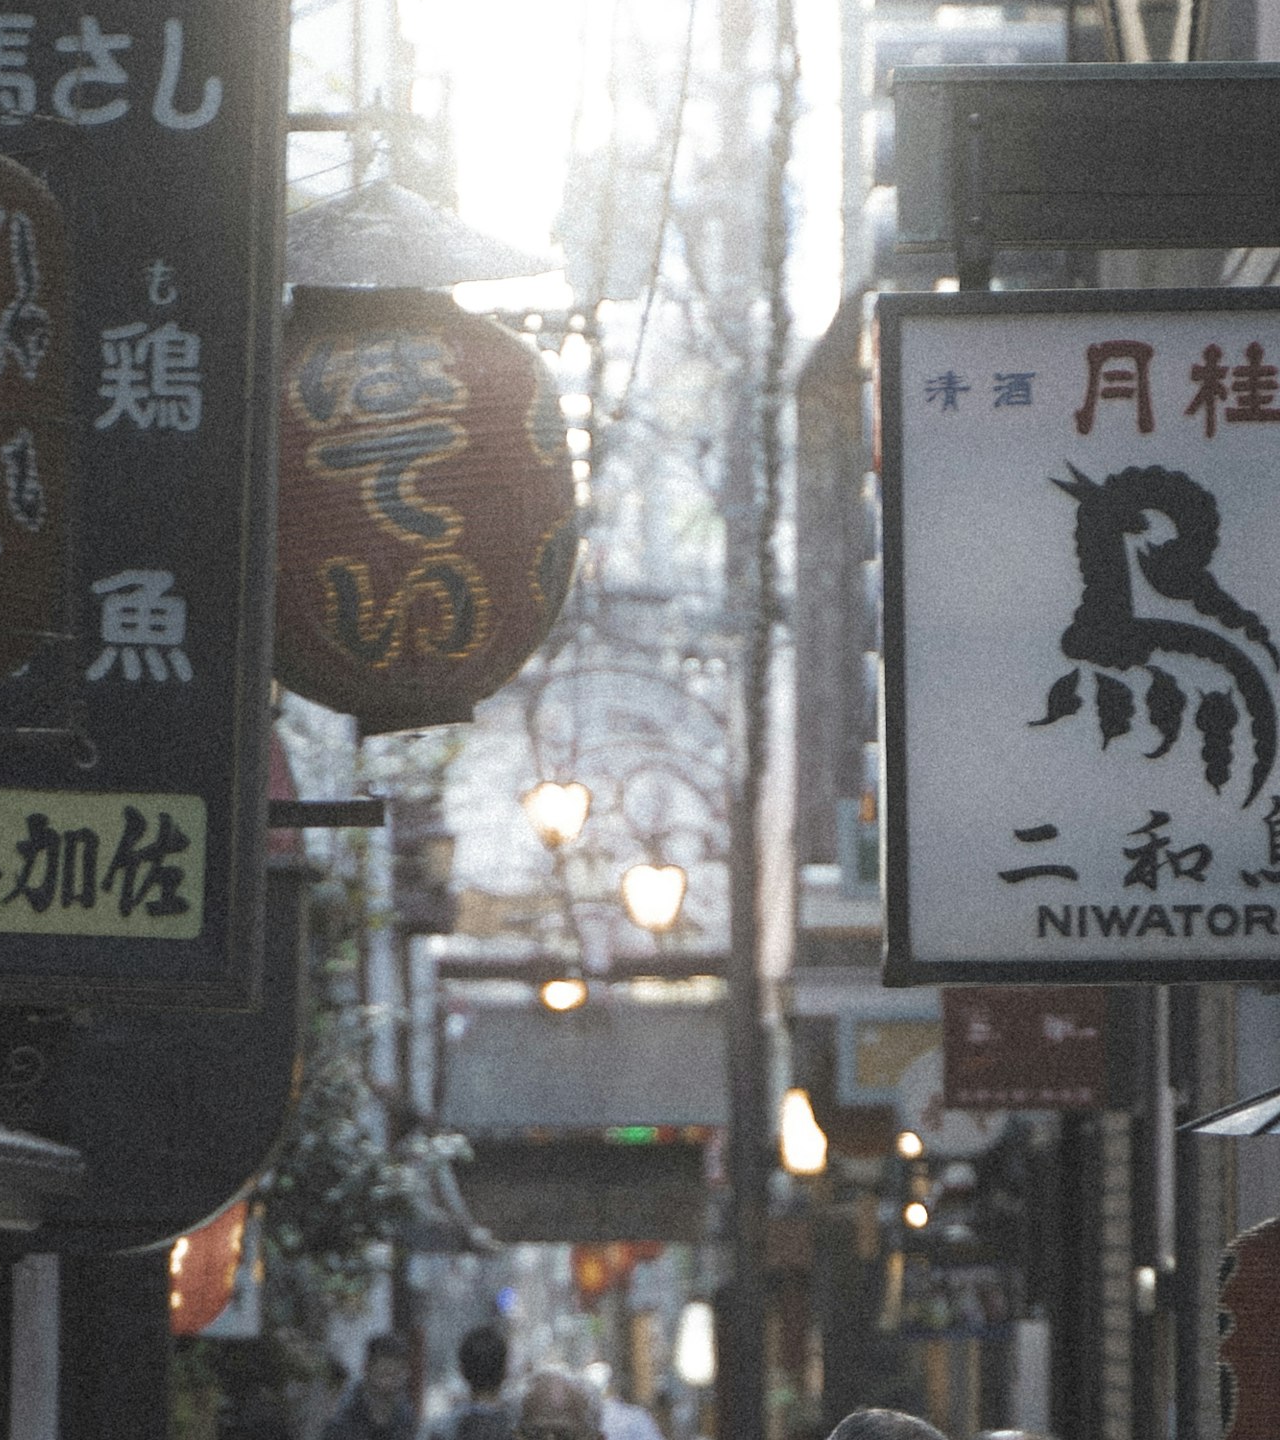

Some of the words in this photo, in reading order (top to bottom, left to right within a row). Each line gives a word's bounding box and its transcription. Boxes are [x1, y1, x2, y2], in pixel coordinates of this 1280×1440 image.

[925, 370, 1038, 413] 清酒
[289, 330, 491, 669] ほてい
